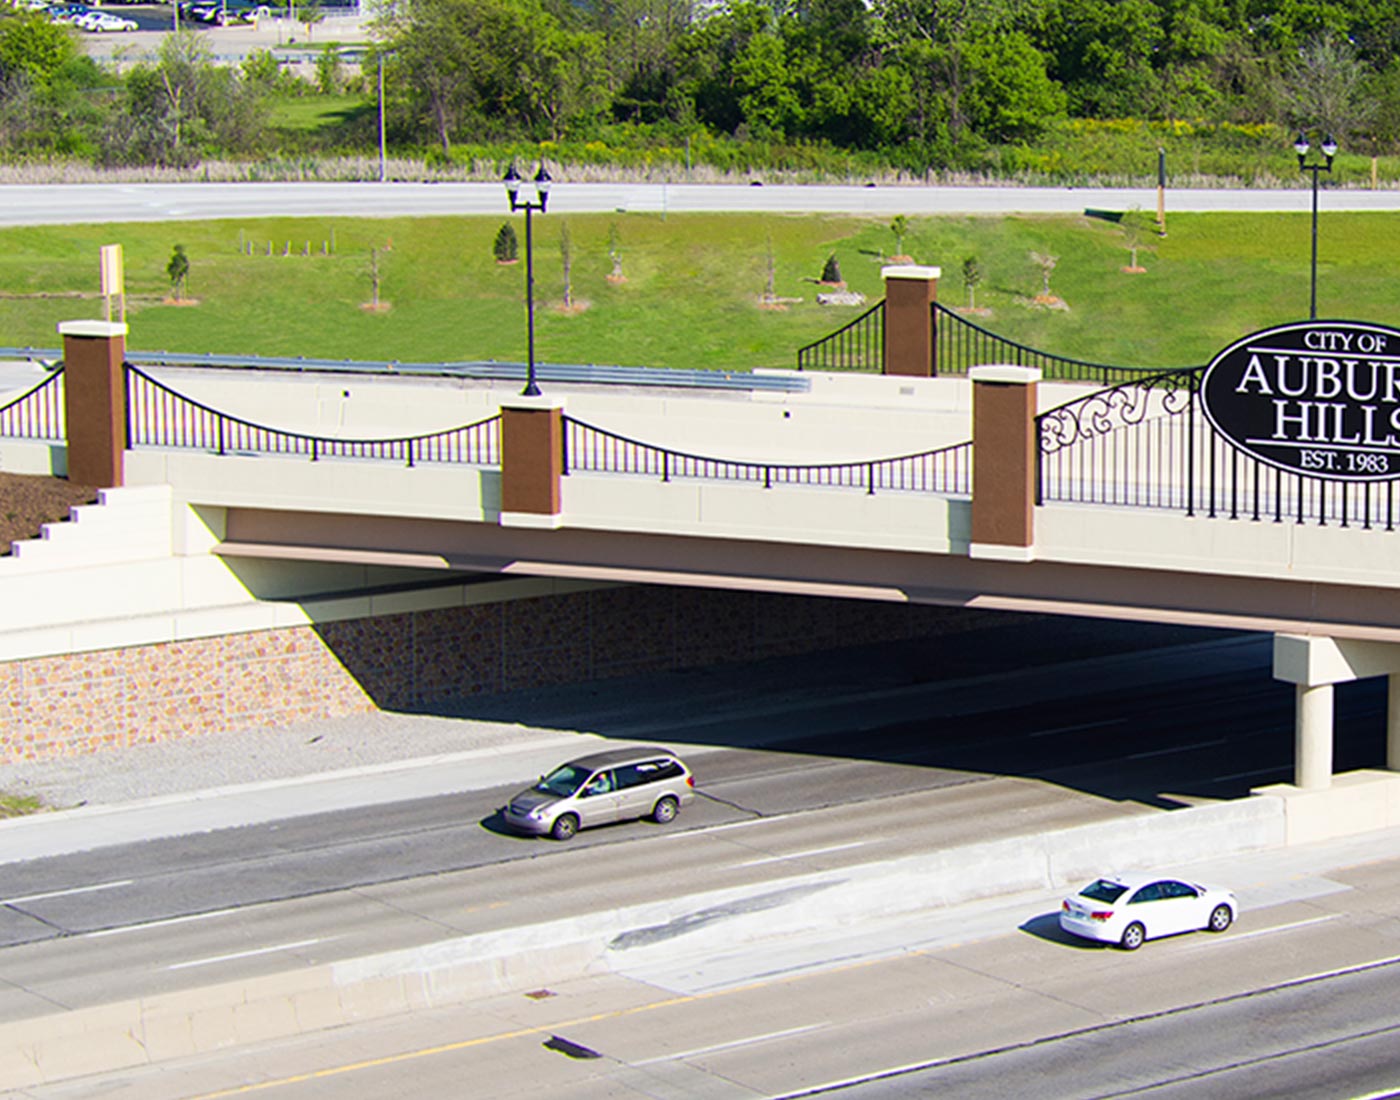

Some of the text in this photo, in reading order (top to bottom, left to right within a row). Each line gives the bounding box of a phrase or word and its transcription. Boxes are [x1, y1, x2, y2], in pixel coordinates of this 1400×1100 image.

[1304, 330, 1387, 353] CITY OF
[1300, 449, 1389, 473] EST. 1983
